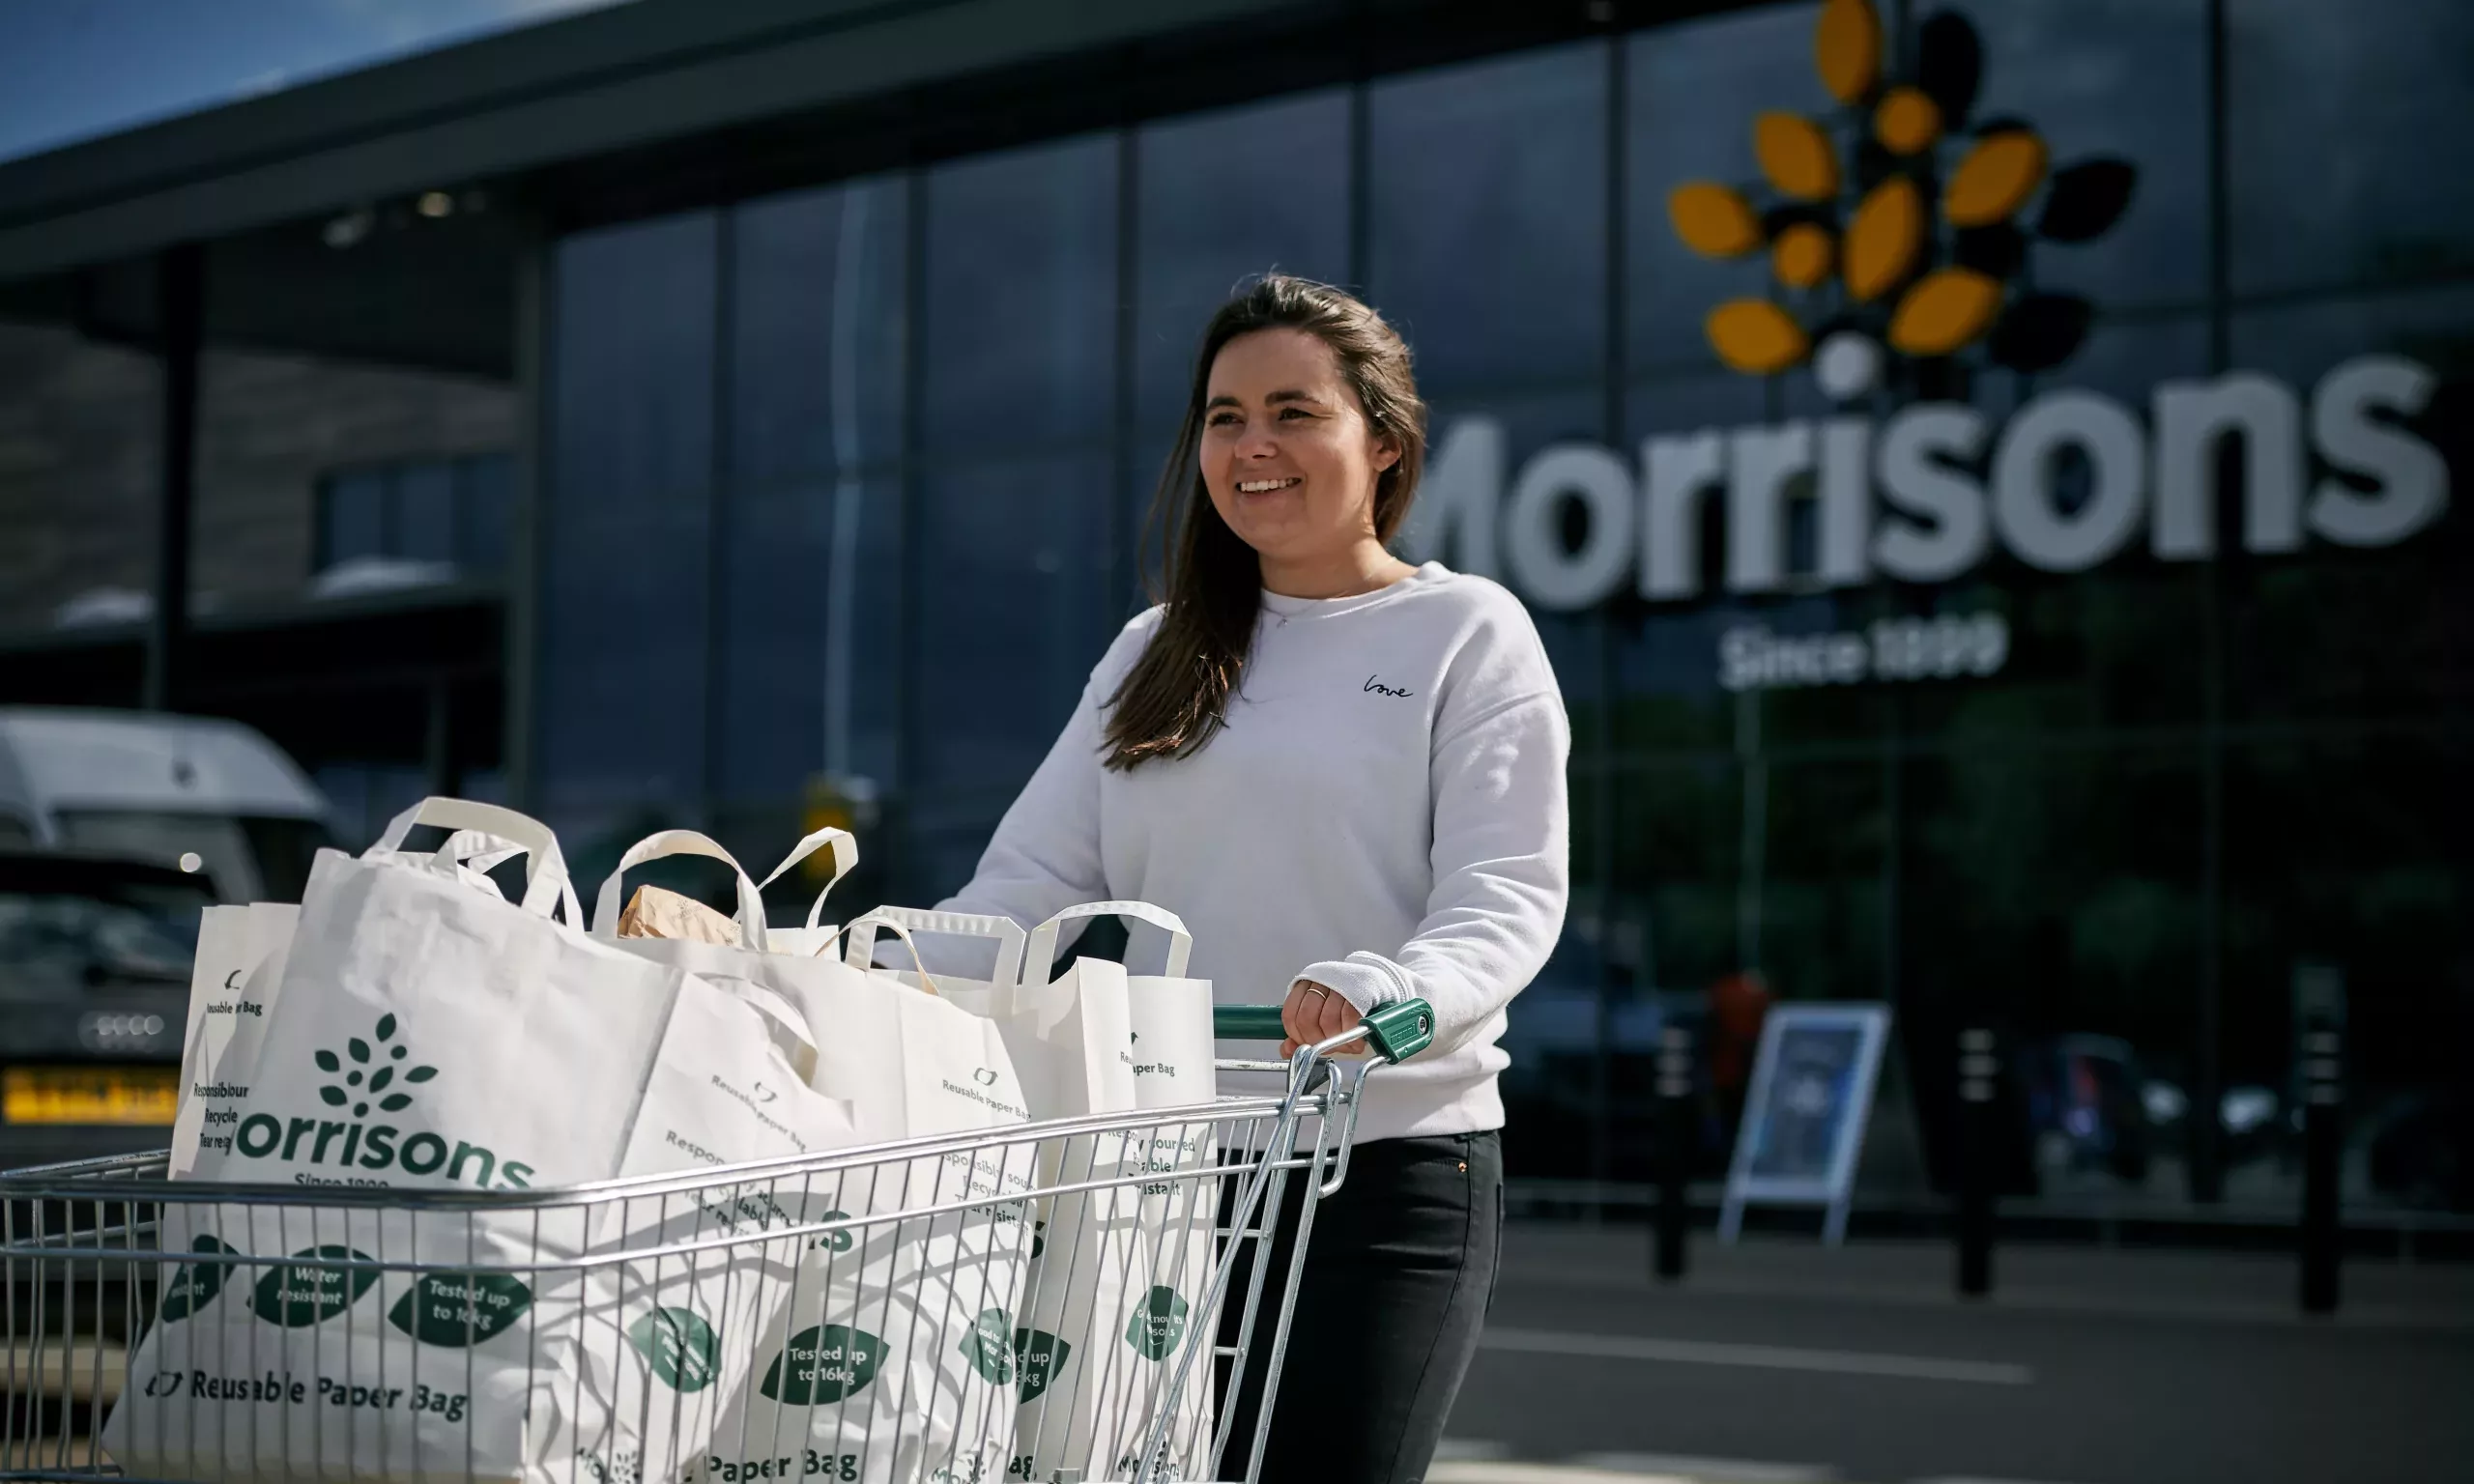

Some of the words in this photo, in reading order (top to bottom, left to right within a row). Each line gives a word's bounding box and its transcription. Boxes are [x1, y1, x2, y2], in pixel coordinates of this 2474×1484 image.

[1718, 622, 1868, 690] Since
[1158, 1062, 1175, 1077] Bag
[942, 1079, 984, 1103] Reusable
[985, 1097, 1013, 1113] Paper
[487, 1292, 511, 1310] up
[433, 1303, 451, 1321] to
[1030, 1353, 1050, 1367] up
[1008, 1455, 1037, 1483] ag
